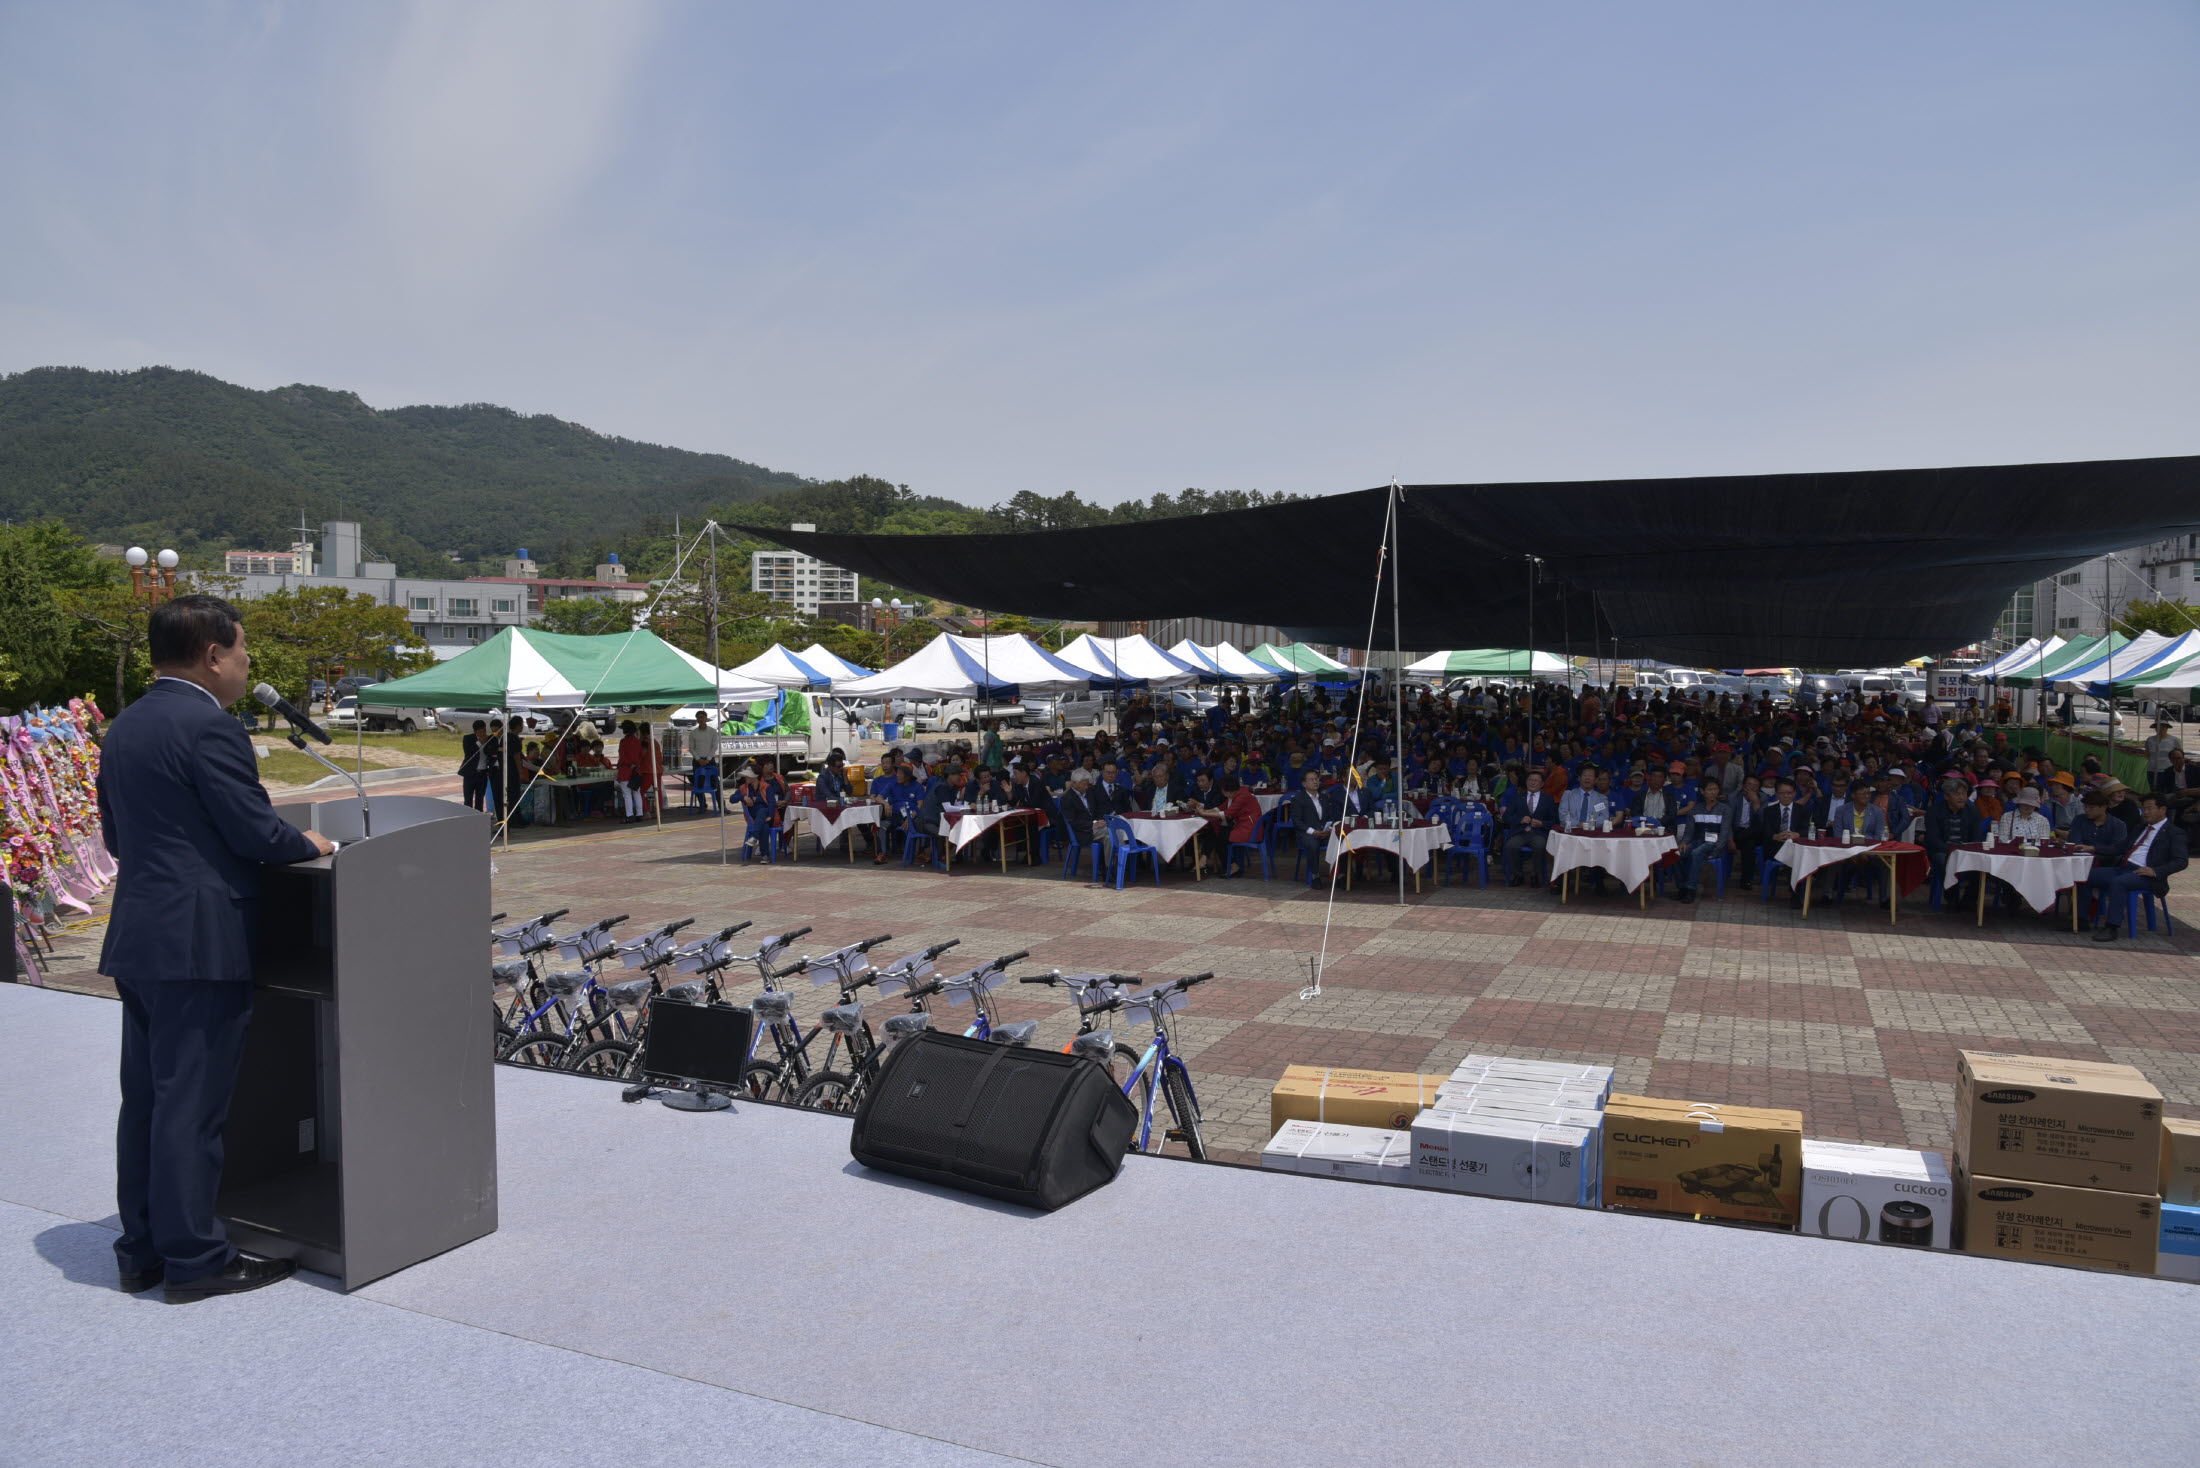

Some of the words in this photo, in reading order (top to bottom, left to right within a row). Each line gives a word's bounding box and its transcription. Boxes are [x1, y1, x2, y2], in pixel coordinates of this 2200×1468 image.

[1986, 1091, 2030, 1102] SAMSUNG
[1999, 1113, 2017, 1123] 삼성
[2018, 1115, 2066, 1129] 전자레인지
[2078, 1124, 2115, 1136] Microwave
[2116, 1128, 2135, 1137] Oven
[1612, 1132, 1691, 1149] CUCHEN
[1418, 1169, 1444, 1178] ELECTRIC
[1459, 1160, 1488, 1175] 선풍기
[1894, 1183, 1948, 1197] CUCKOO
[1984, 1189, 2028, 1200] SAMSUNG
[1995, 1210, 2015, 1222] 삼성
[2016, 1212, 2064, 1228] 전자레인지
[2075, 1222, 2113, 1234] Microwave
[2113, 1226, 2132, 1236] Oven
